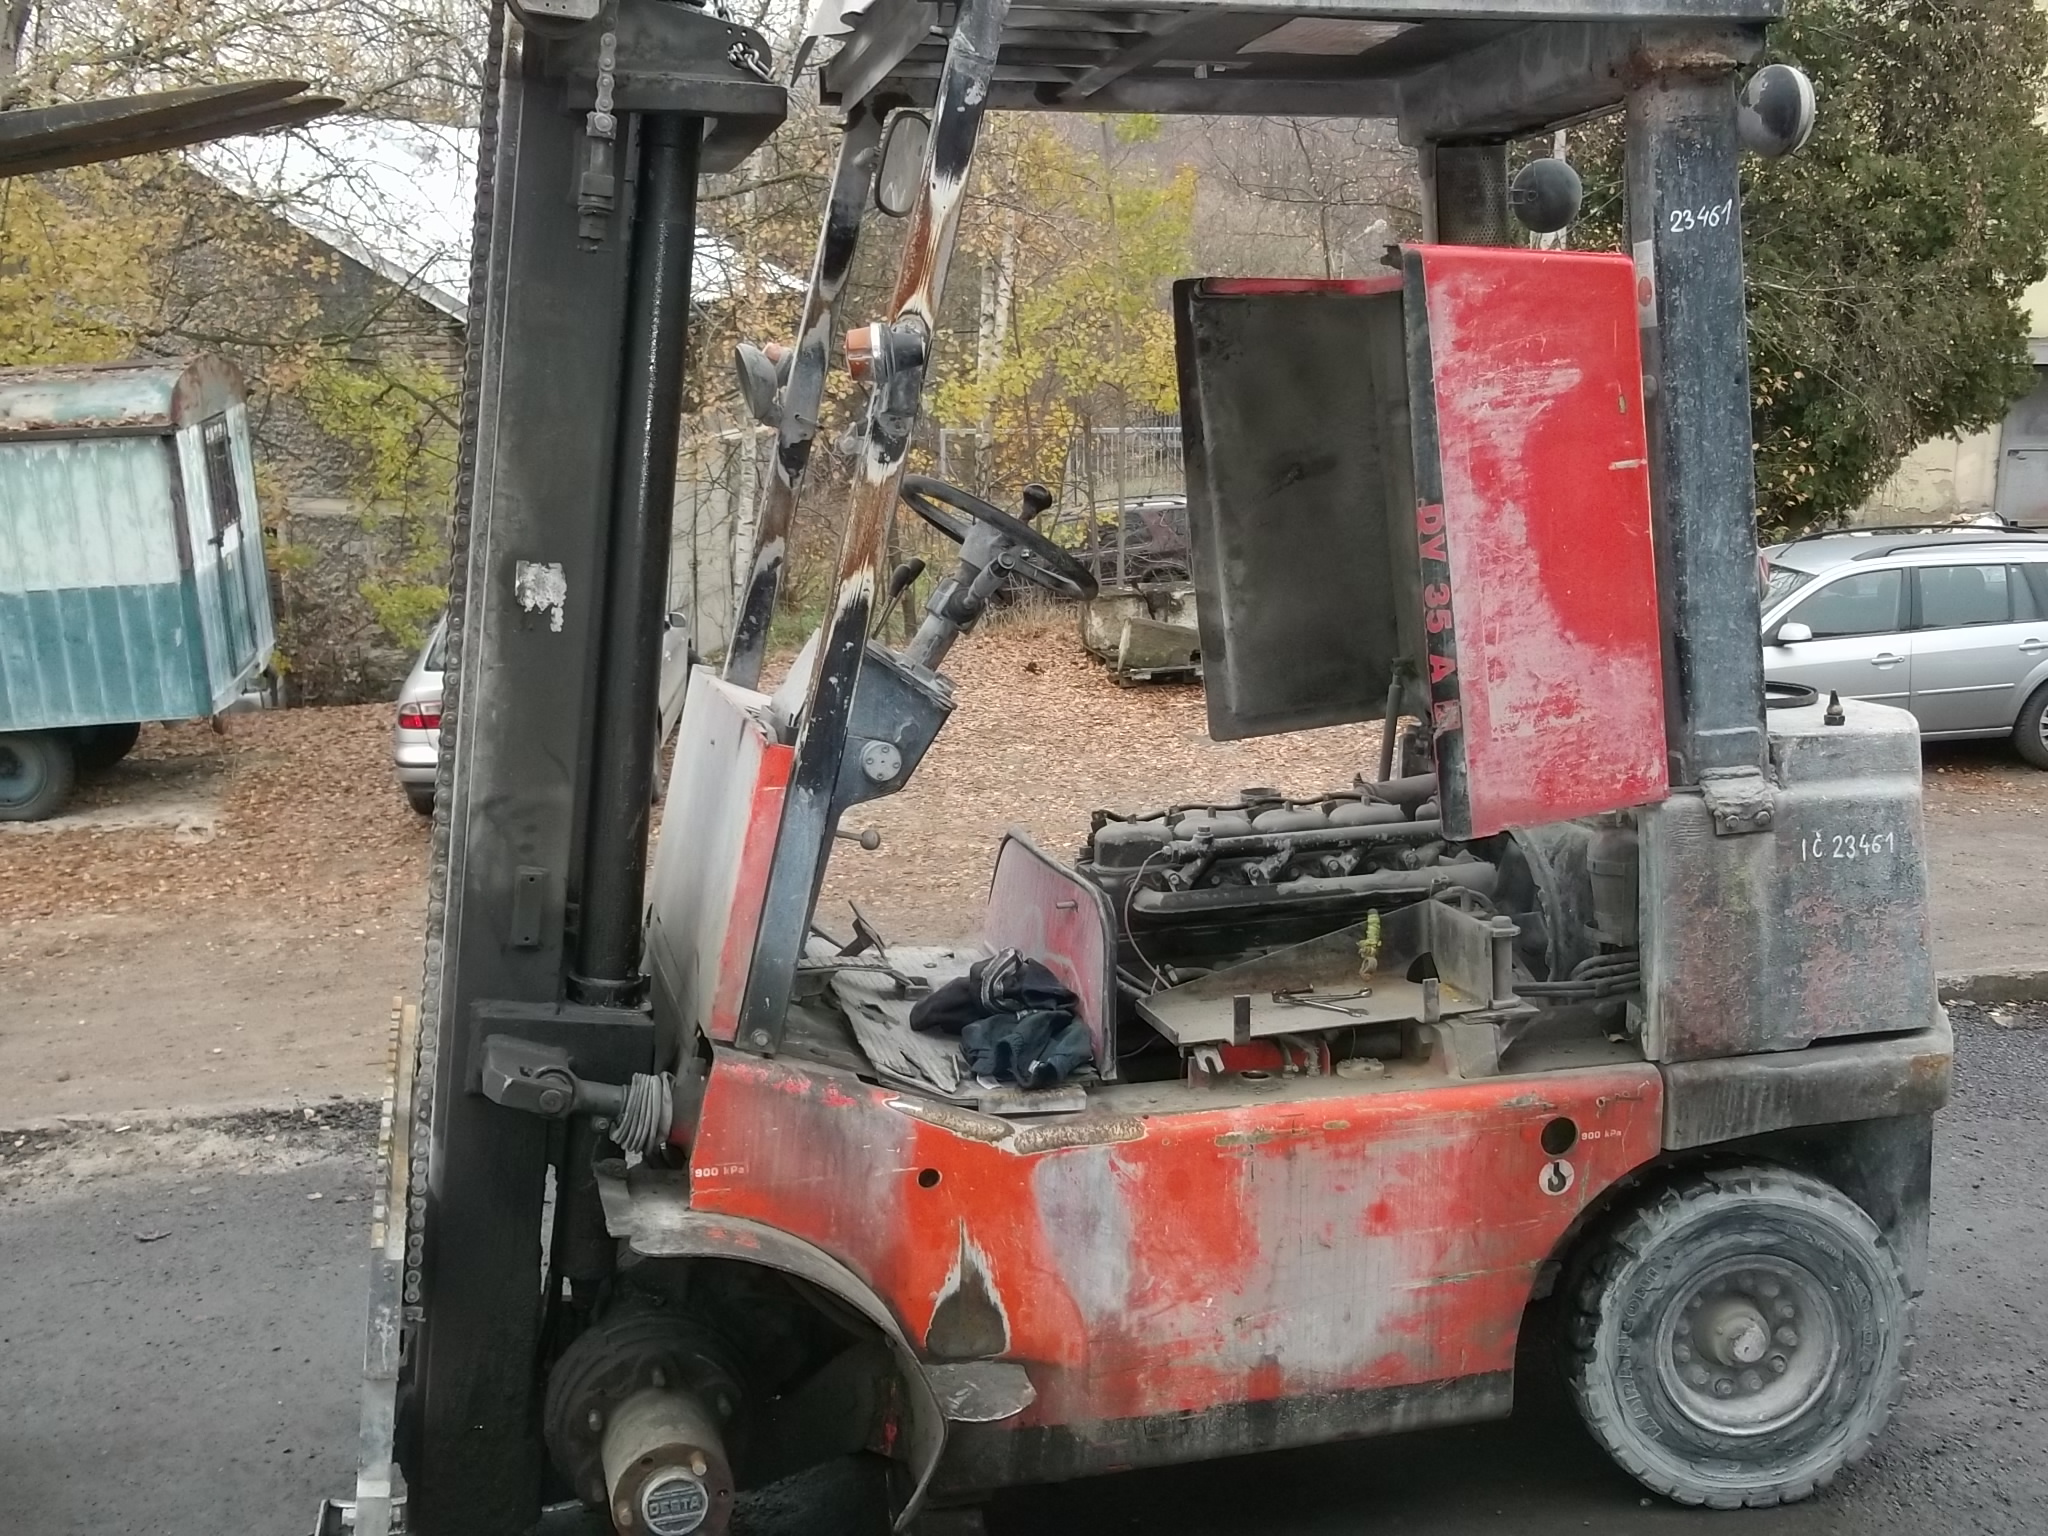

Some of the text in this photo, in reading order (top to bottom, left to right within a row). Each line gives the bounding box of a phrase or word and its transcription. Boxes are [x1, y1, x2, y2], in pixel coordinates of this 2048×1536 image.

[1670, 198, 1732, 232] 23461
[1417, 504, 1446, 562] DV
[1424, 582, 1453, 634] 35
[1430, 654, 1456, 684] A
[1833, 832, 1893, 858] 23461
[1582, 1128, 1622, 1141] 900 kPa
[695, 1166, 745, 1178] 900 kPa
